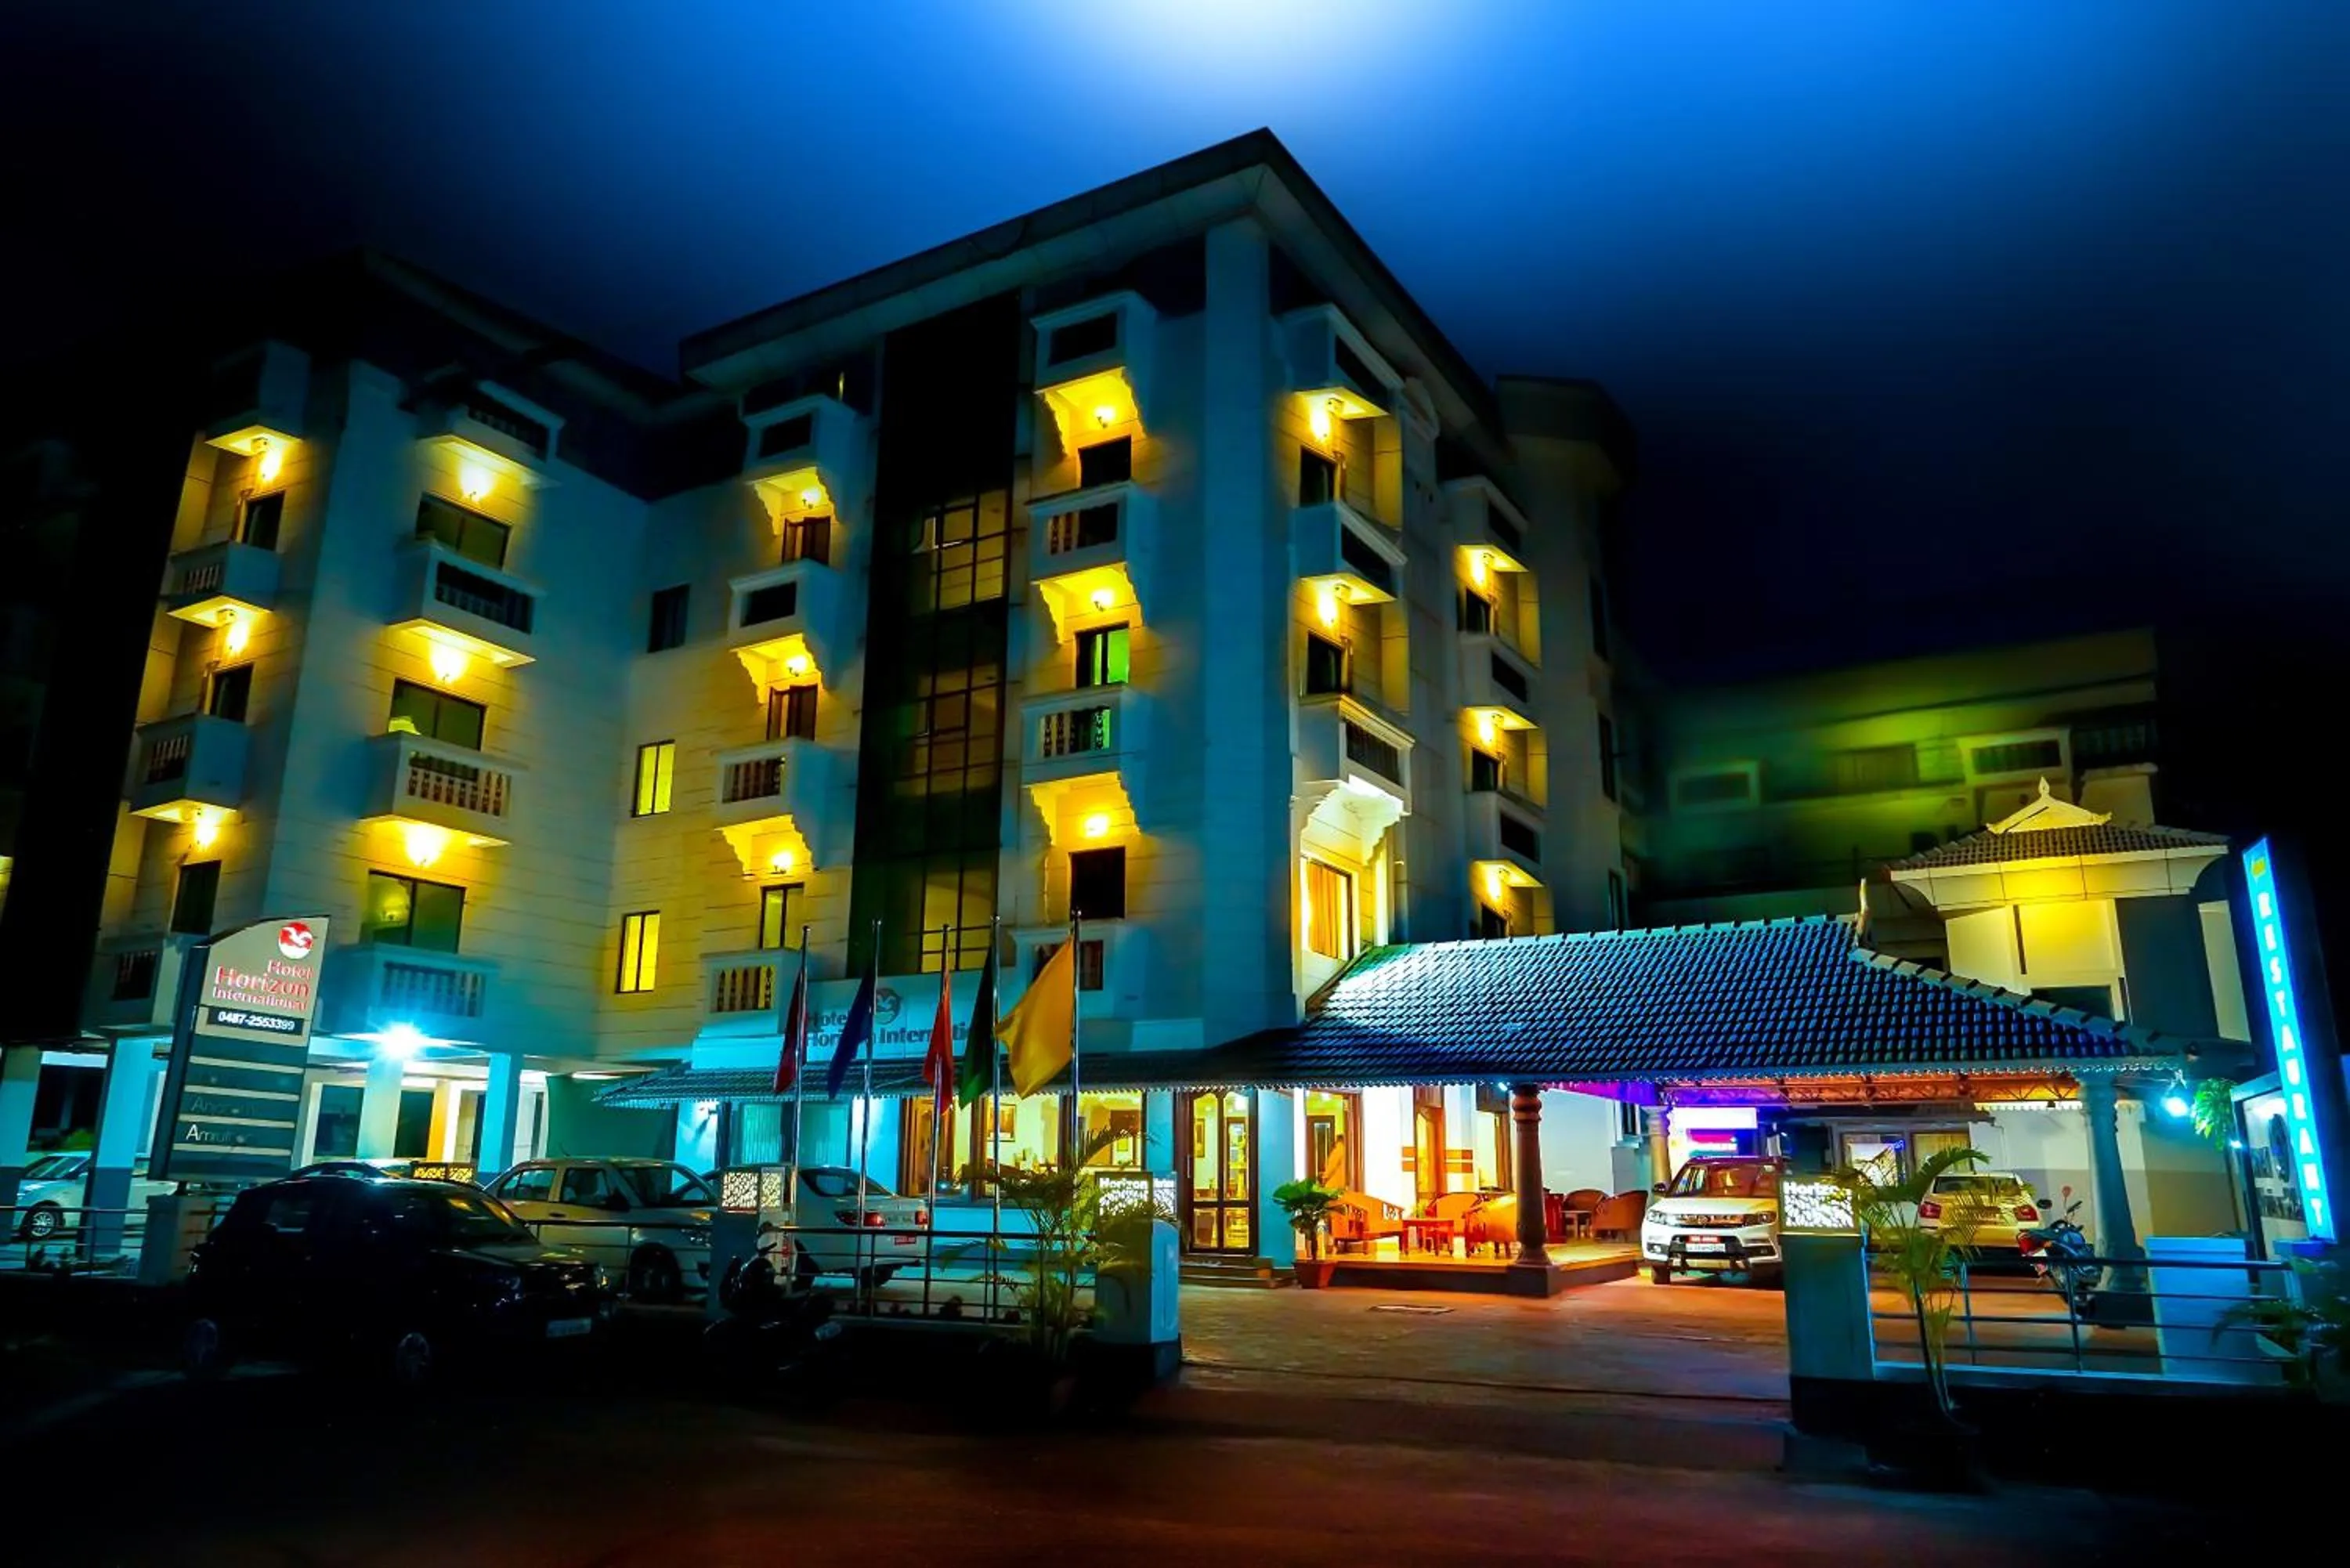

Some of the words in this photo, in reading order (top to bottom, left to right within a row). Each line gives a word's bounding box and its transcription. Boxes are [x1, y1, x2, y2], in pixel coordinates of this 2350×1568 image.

[215, 966, 310, 997] Horizon
[267, 959, 313, 979] Hotel
[808, 1010, 850, 1026] Hote
[2258, 891, 2322, 1227] RESTAURANT
